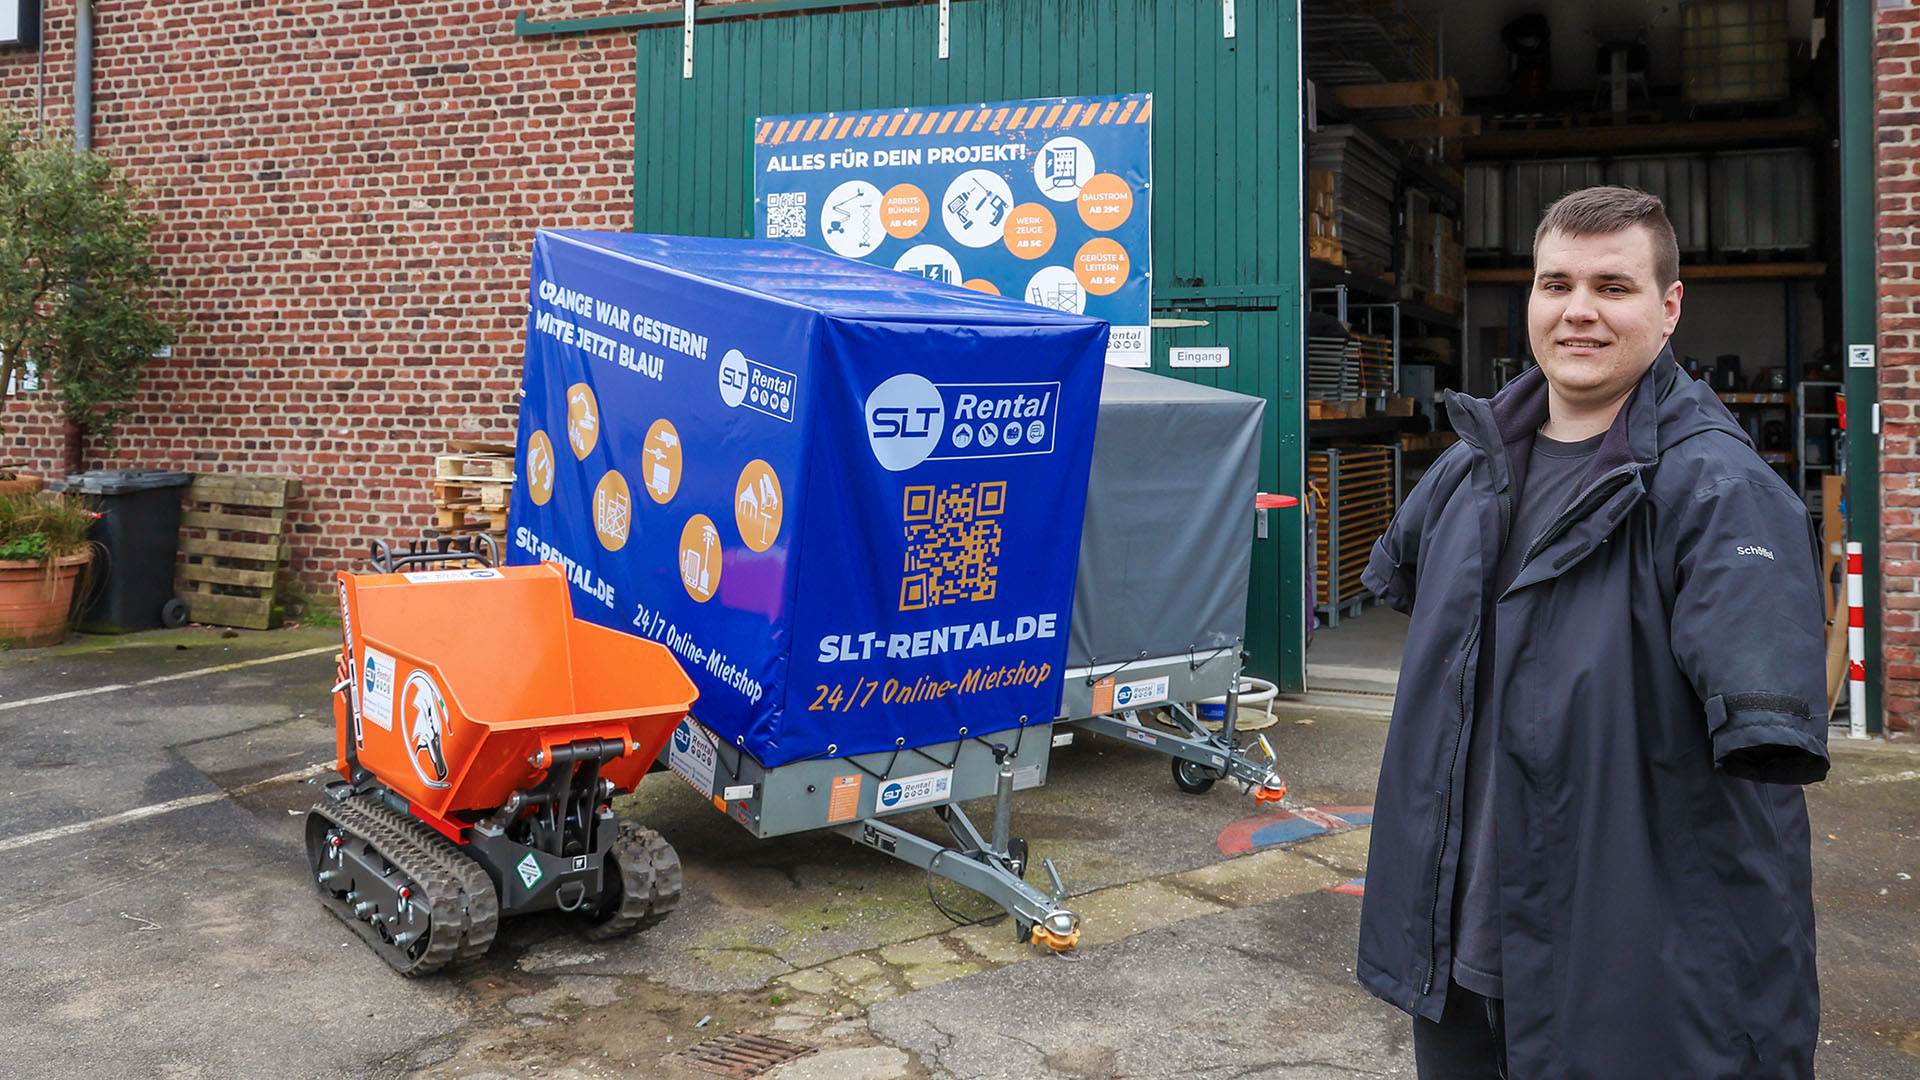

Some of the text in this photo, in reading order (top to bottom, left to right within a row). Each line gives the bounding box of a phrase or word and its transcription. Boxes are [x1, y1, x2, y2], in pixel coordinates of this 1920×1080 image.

[766, 144, 1026, 172] ALLES FÜR DEIN PROJEKT!
[888, 197, 920, 205] ARBEITS-
[1082, 192, 1128, 201] BAUSTROM
[888, 205, 920, 214] BÜHNEN
[1089, 206, 1102, 214] AB
[890, 219, 901, 227] AB
[1016, 216, 1043, 225] WERK-
[1016, 226, 1043, 234] ZEUGE
[1016, 240, 1029, 248] AB
[1080, 252, 1125, 262] GERÜSTE &
[1085, 263, 1119, 272] LEITERN
[1090, 276, 1102, 284] AB
[539, 279, 708, 361] ORANGE WAR GESTERN!
[576, 326, 618, 362] JETZT
[618, 343, 664, 382] BLAU!
[1177, 351, 1222, 363] Eingang
[722, 366, 792, 396] SLT Rental
[872, 391, 1051, 439] SLT Rental
[818, 613, 1057, 663] SLT-RENTAL.DE
[632, 603, 763, 705] 24/7 Online-Mietshop
[808, 676, 879, 712] 24/7
[882, 659, 1051, 705] Online-Mietshop
[675, 727, 714, 757] SLT Rental
[883, 780, 931, 801] SLT Rental
